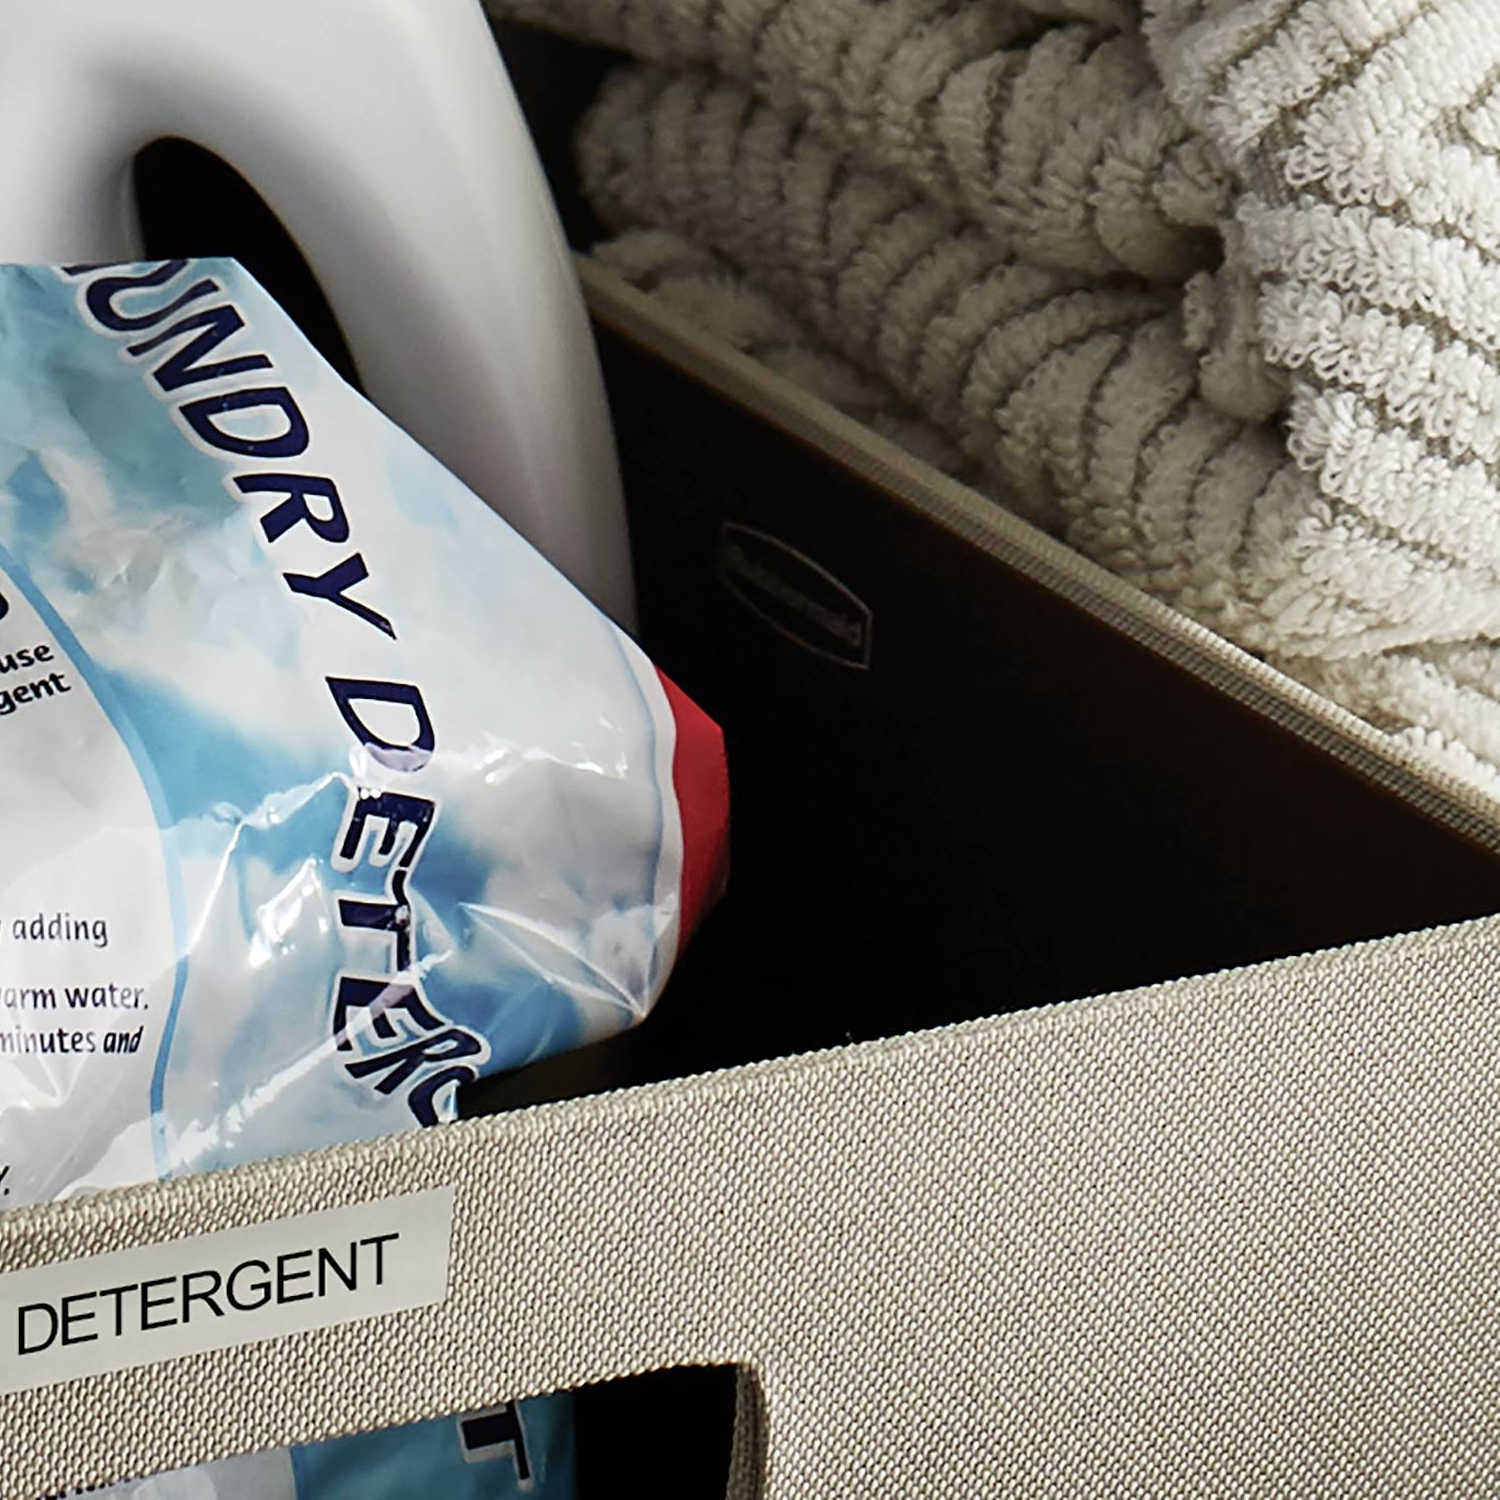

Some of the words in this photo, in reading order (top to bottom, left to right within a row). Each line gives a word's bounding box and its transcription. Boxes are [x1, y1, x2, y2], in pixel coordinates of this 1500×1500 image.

[11, 912, 109, 949] adding
[103, 1025, 145, 1055] and
[15, 1231, 402, 1357] DETERGENT
